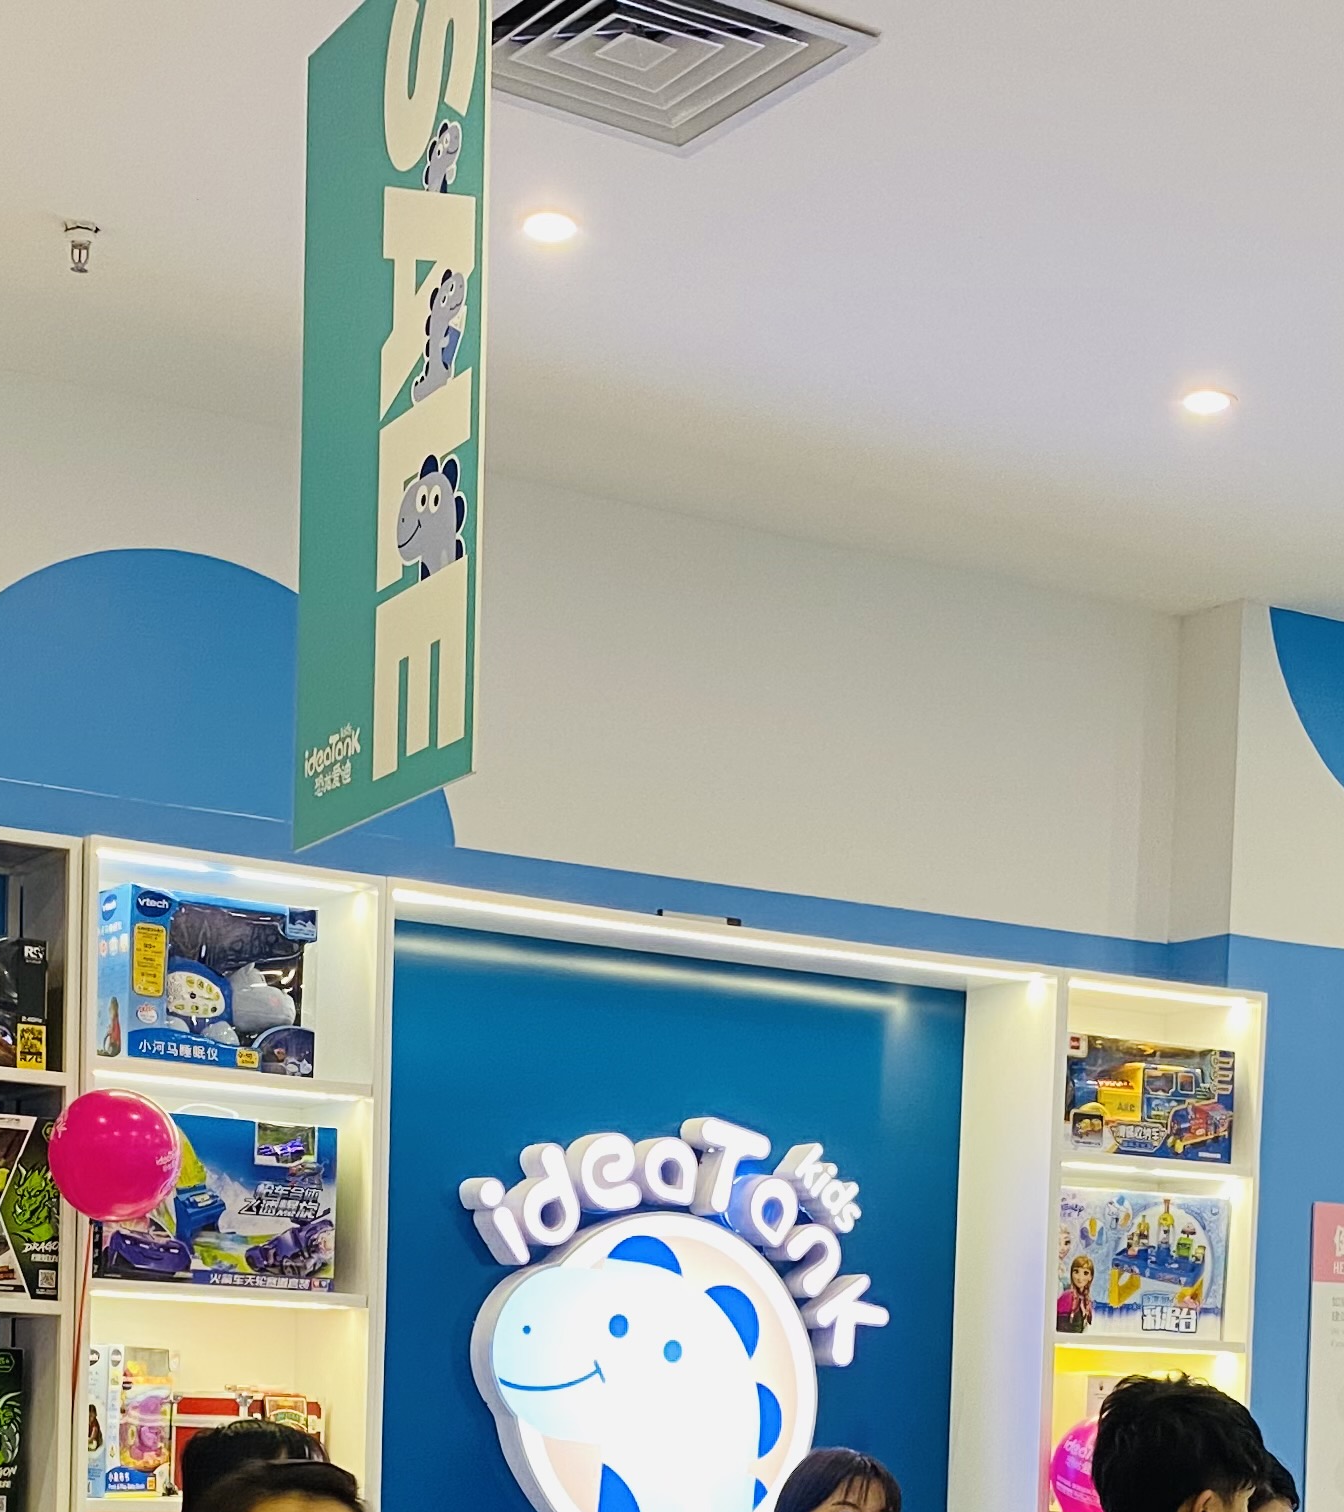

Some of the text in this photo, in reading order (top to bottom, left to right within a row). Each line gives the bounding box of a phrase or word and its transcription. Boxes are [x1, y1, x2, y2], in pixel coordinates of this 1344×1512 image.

[373, 0, 476, 781] SALE
[137, 897, 169, 909] vtech
[139, 1040, 219, 1061] 小河马睡眠仪
[774, 1142, 861, 1233] kids
[22, 1242, 58, 1253] DRAGO
[459, 1117, 890, 1367] ideaTank
